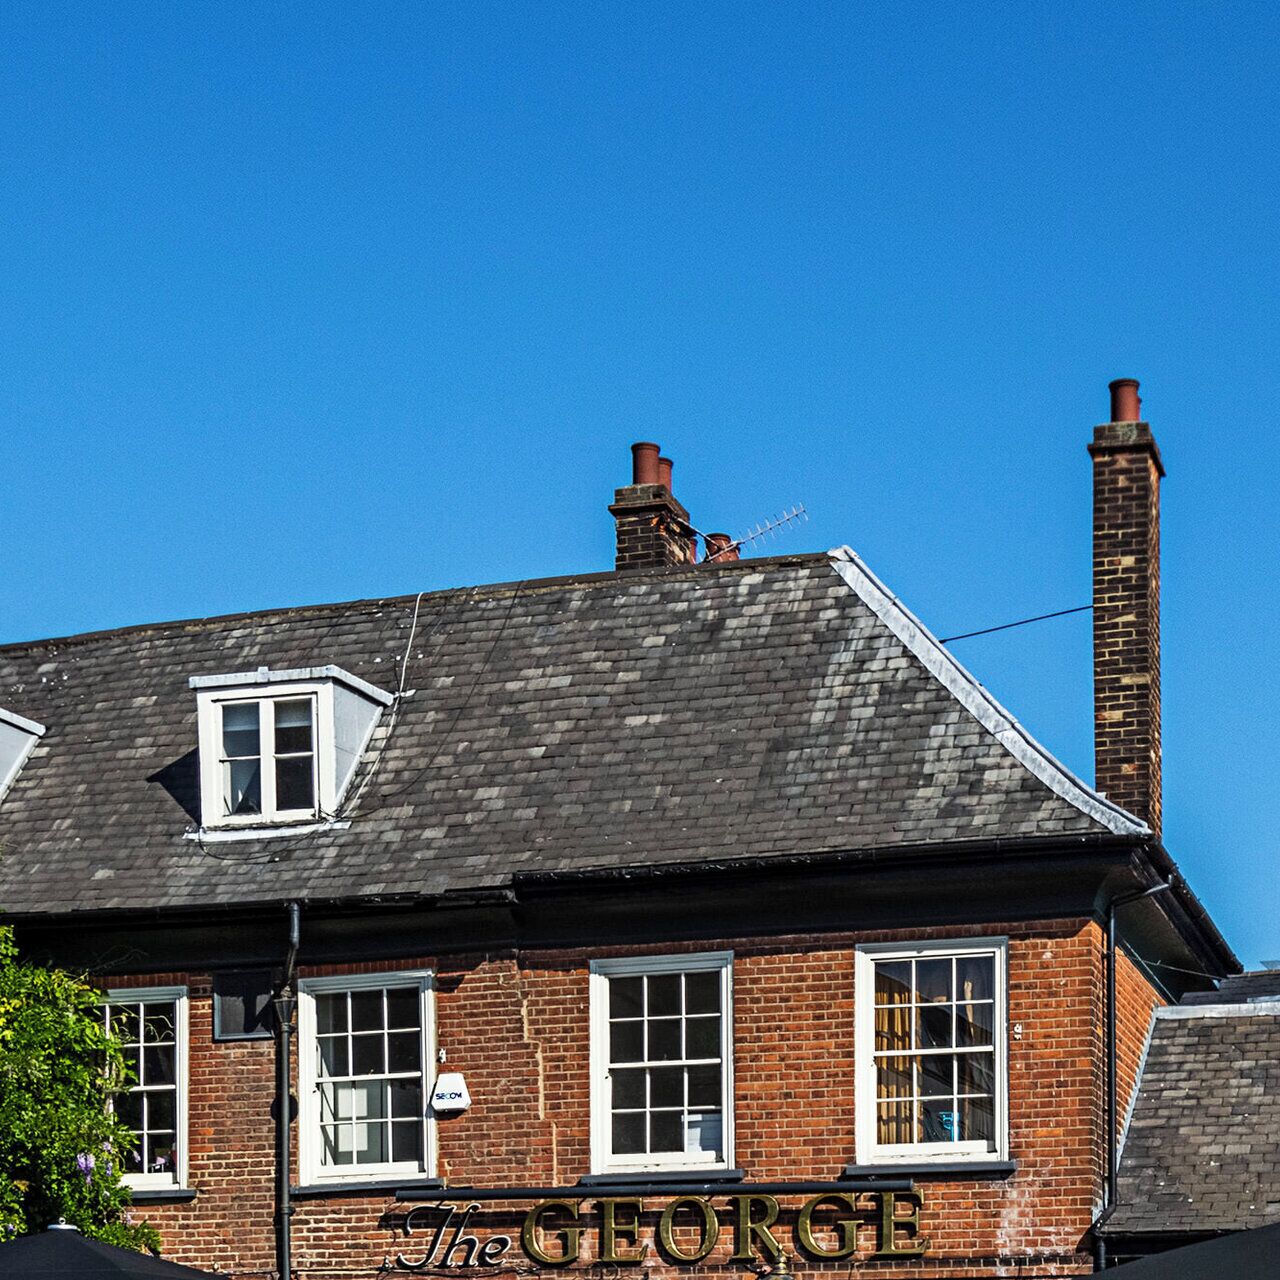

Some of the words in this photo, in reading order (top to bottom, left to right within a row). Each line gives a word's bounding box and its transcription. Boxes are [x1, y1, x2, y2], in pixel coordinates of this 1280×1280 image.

[436, 1092, 462, 1100] SECOM
[398, 1202, 513, 1269] The
[523, 1189, 928, 1265] GEORGE
